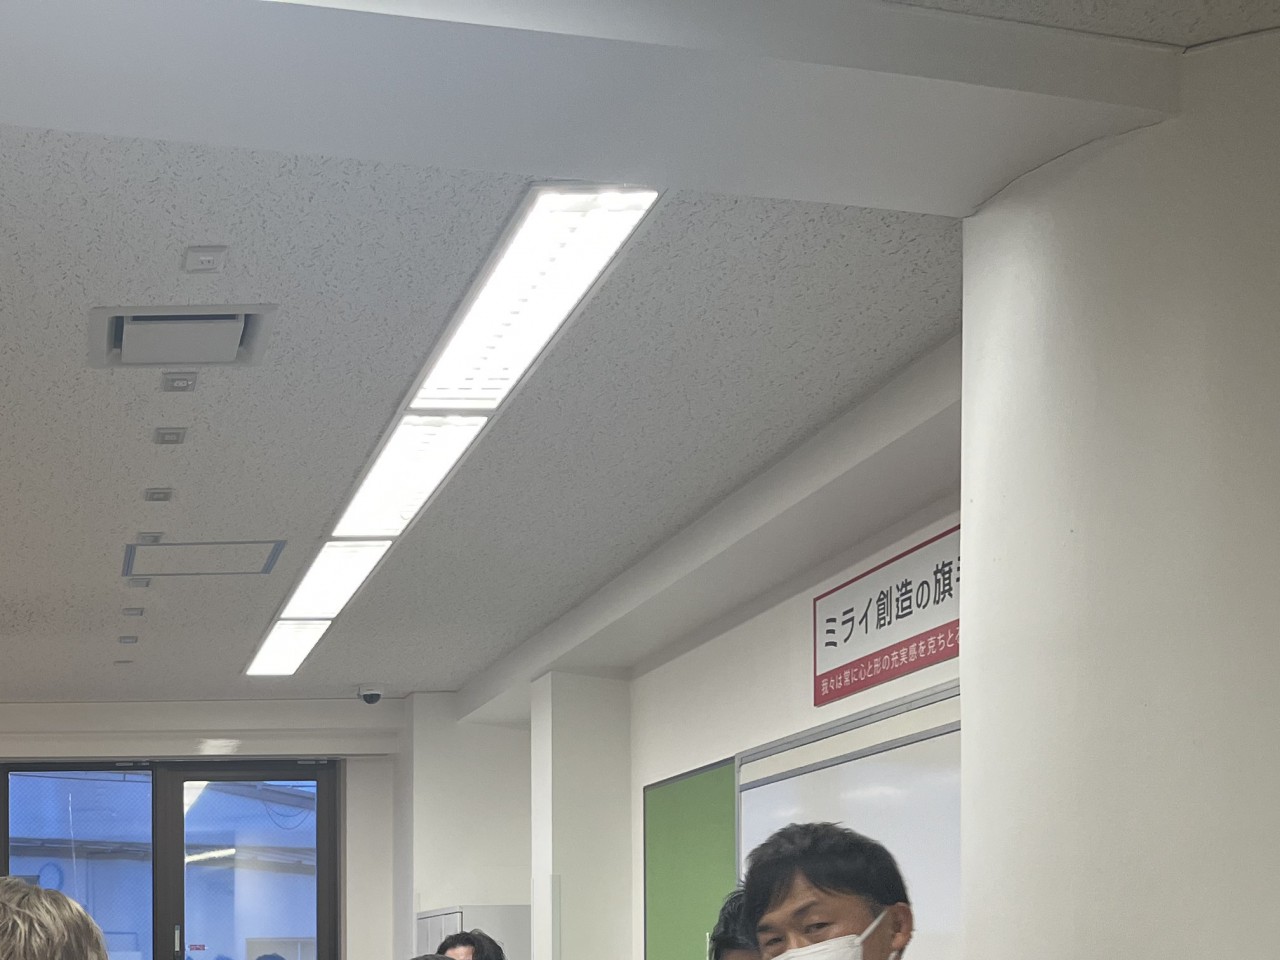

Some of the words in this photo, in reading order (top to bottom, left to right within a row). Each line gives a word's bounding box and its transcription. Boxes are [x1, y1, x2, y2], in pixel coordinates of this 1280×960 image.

[825, 556, 960, 647] ミライ創造の旗
